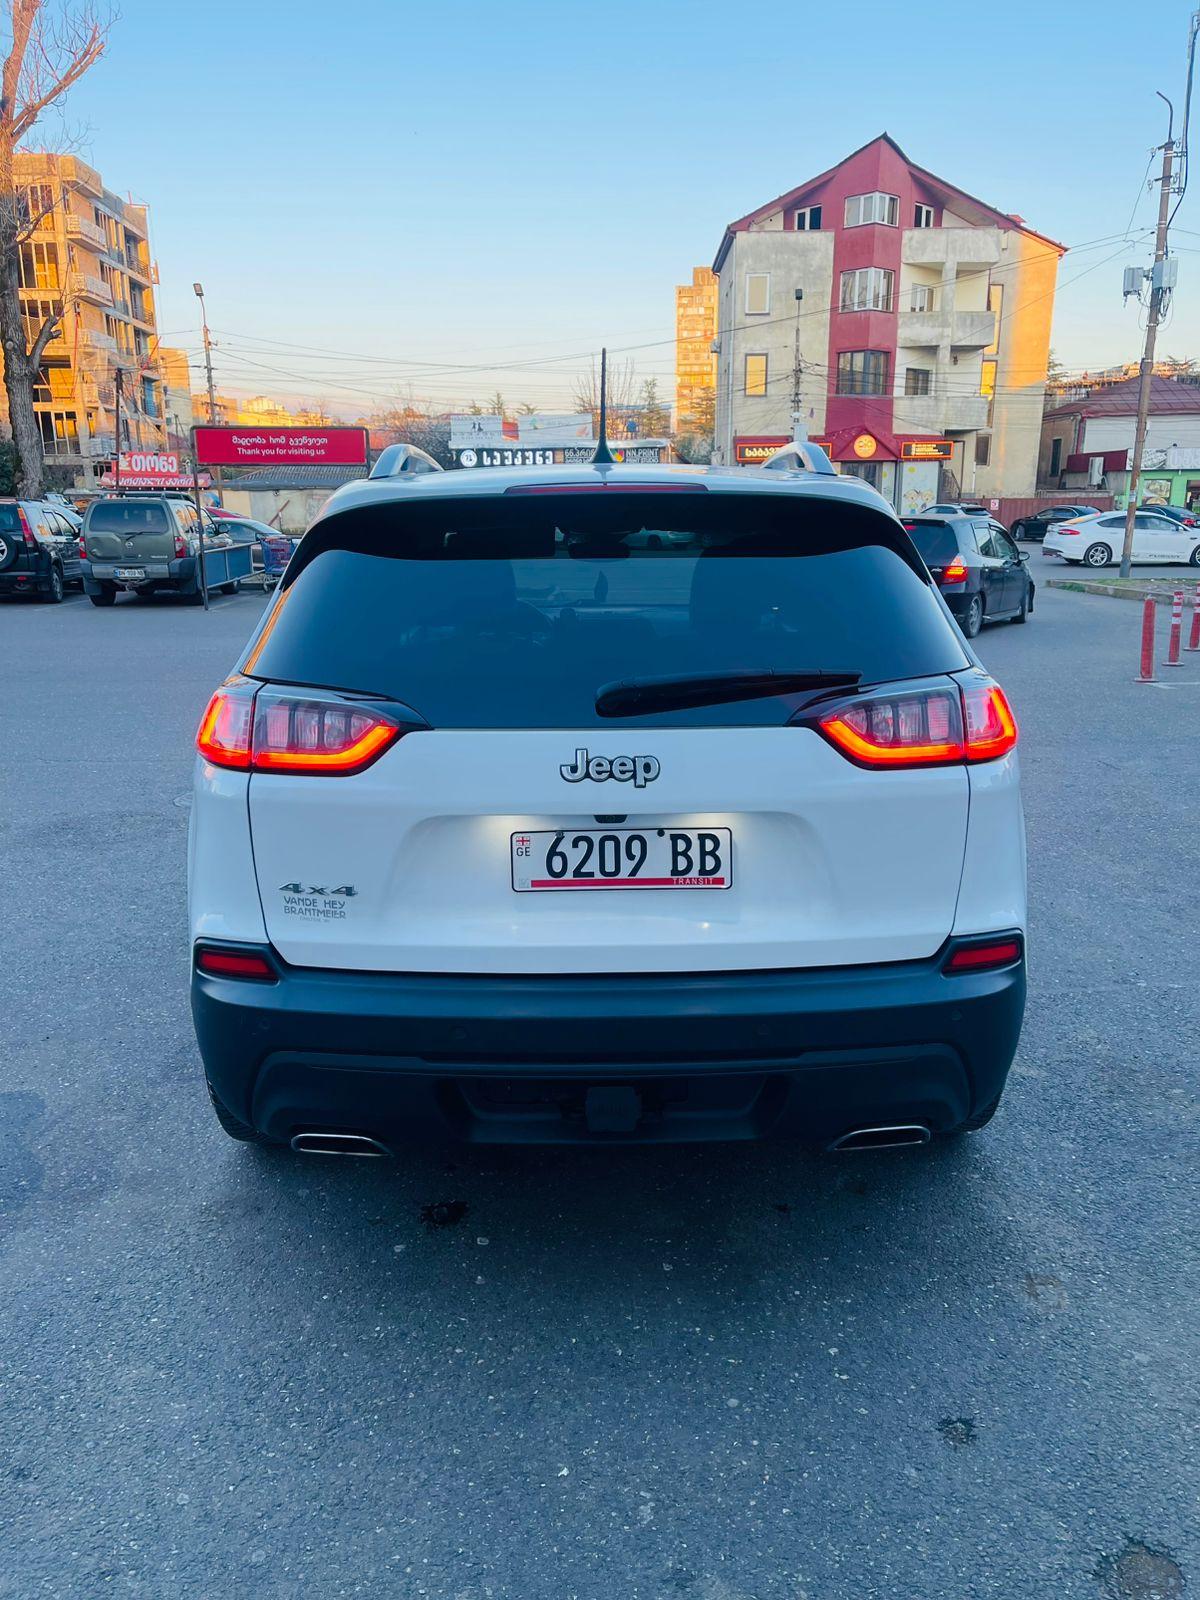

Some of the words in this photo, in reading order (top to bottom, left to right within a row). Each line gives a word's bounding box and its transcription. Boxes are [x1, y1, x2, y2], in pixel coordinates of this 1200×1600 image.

[232, 435, 266, 446] მადლობა
[269, 435, 286, 444] რომ
[289, 435, 328, 446] გვეწვიეთ
[237, 447, 260, 455] Thank
[276, 447, 286, 455] for
[287, 447, 315, 456] visiting
[482, 450, 553, 465] საუკუნე
[745, 447, 778, 457] საბავ
[132, 454, 177, 472] თონე
[559, 748, 661, 788] Jeep
[516, 847, 531, 857] GE
[545, 833, 648, 878] 6209
[669, 833, 722, 877] BB
[672, 877, 715, 886] TRANSIT
[278, 882, 358, 897] 4x4
[283, 895, 318, 907] VANDE
[323, 899, 346, 910] HEY
[283, 905, 346, 919] BRANTMEIER
